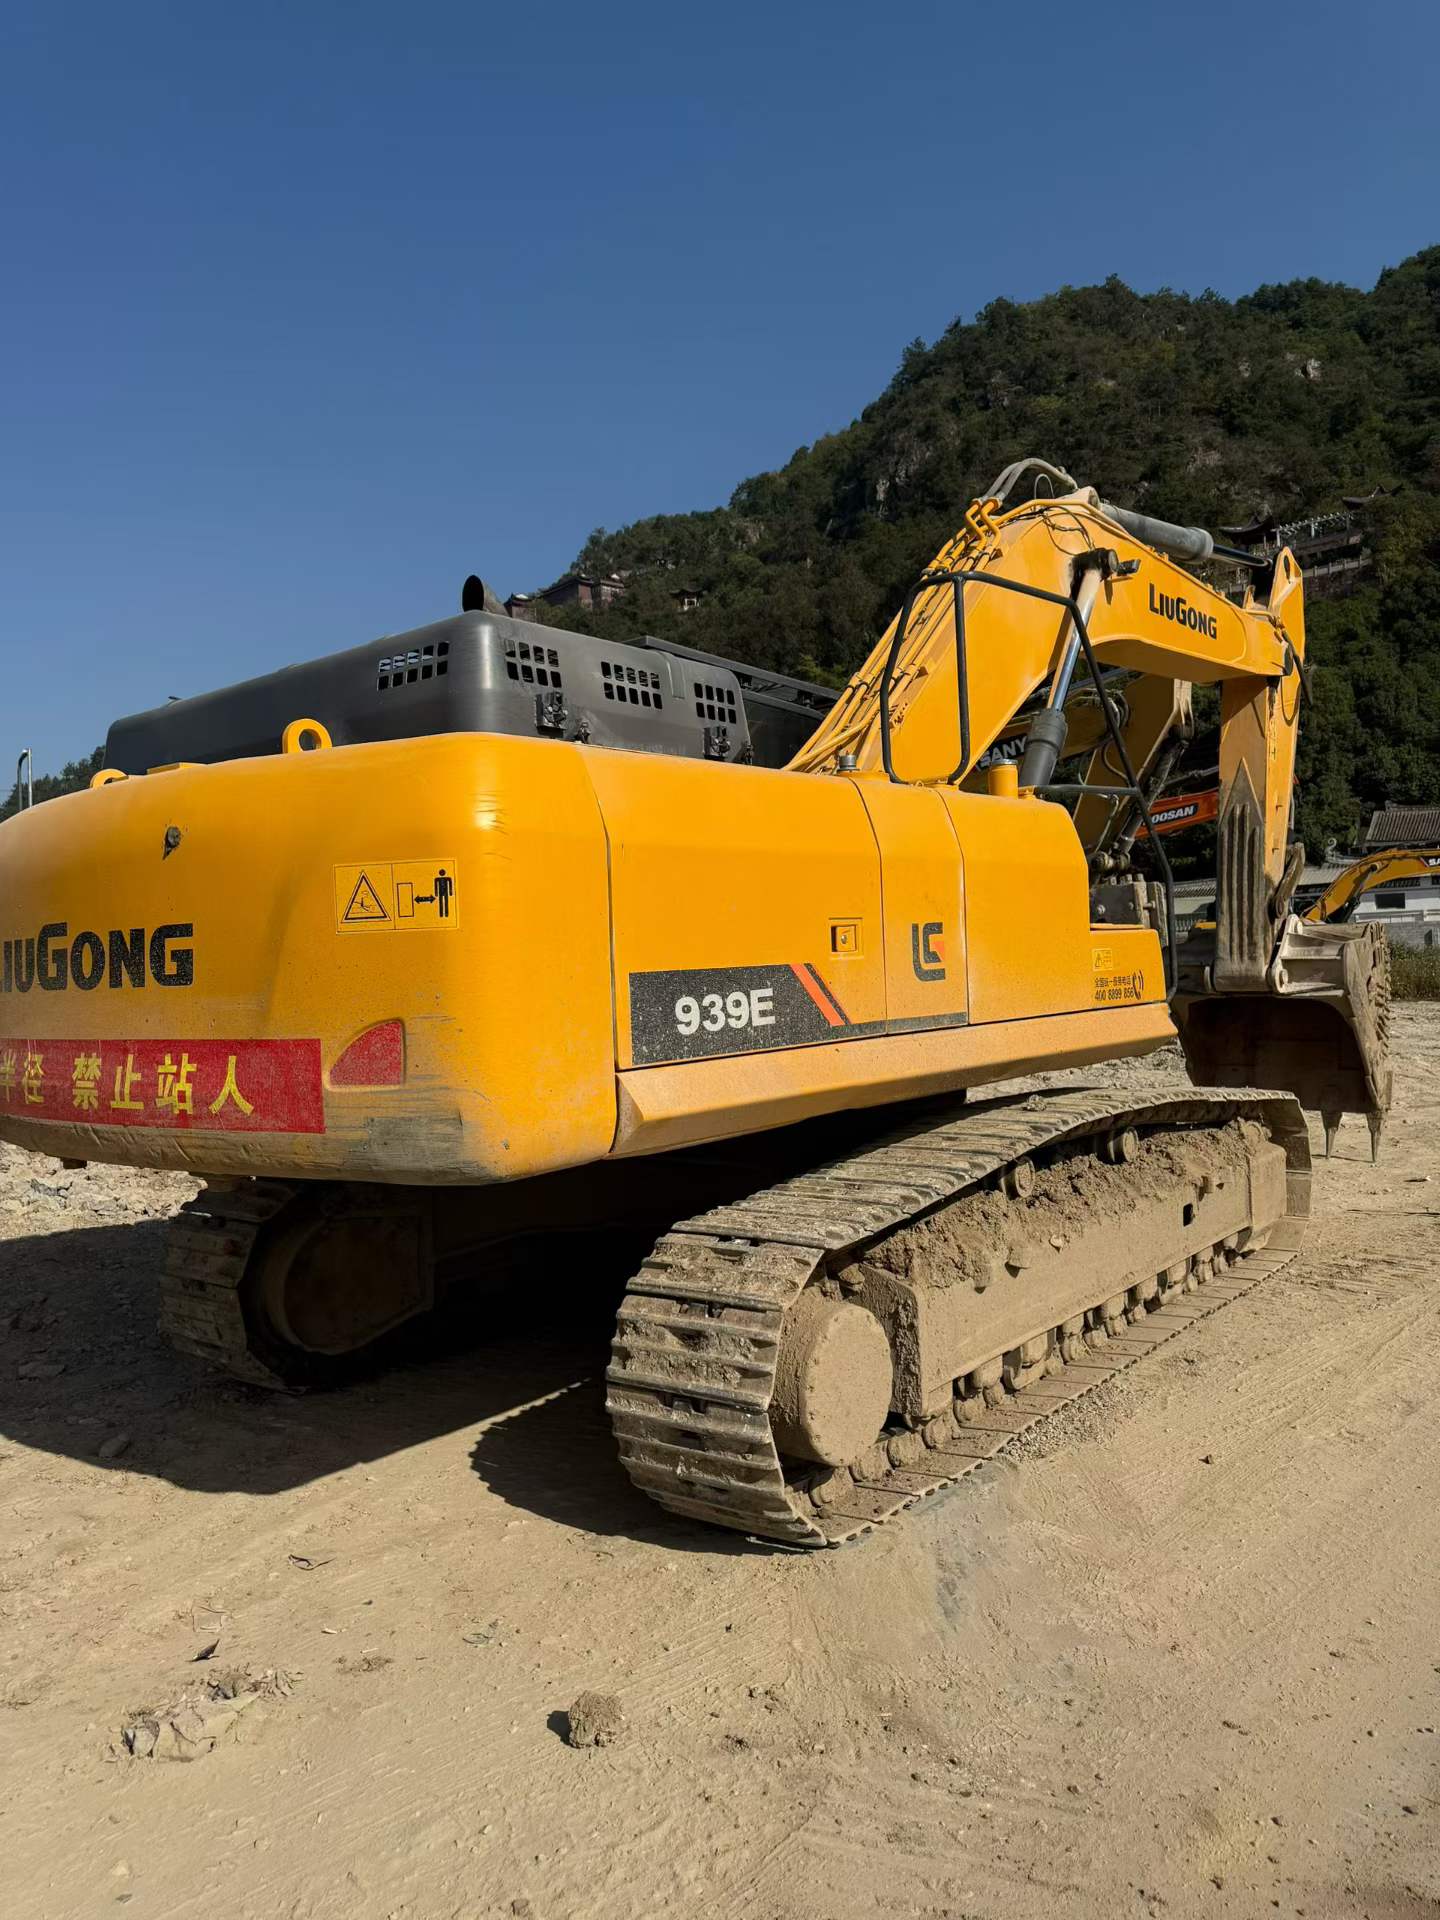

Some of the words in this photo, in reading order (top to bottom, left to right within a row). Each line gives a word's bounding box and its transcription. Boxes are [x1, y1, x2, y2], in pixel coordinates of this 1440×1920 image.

[1150, 805, 1195, 824] OOSAN
[0, 922, 194, 993] IUGONG
[675, 988, 776, 1035] 939E
